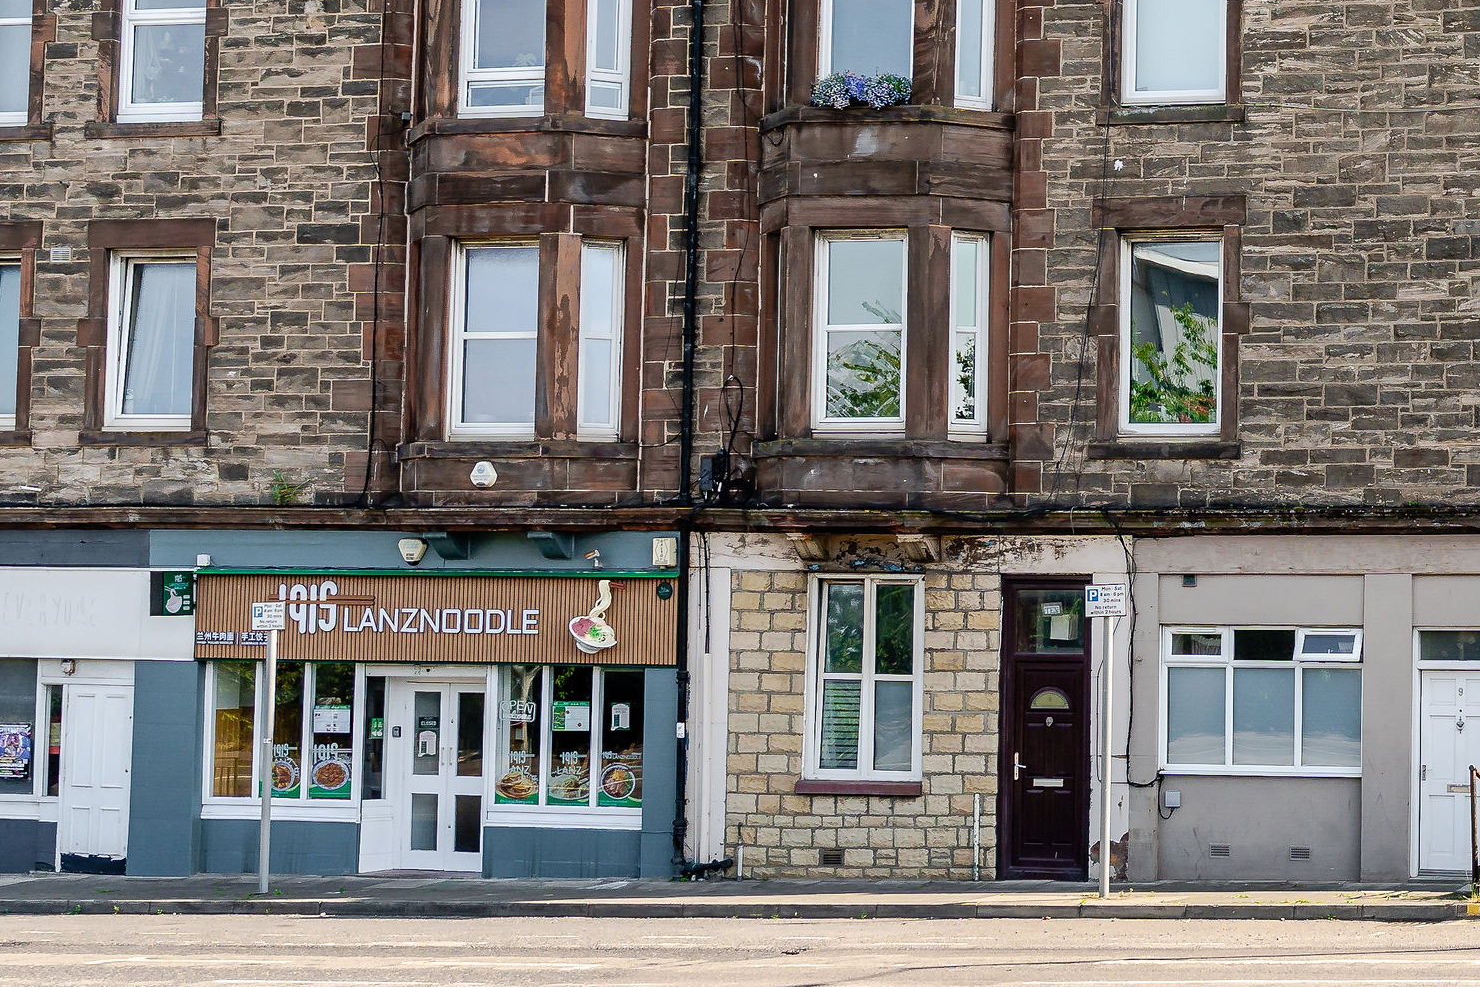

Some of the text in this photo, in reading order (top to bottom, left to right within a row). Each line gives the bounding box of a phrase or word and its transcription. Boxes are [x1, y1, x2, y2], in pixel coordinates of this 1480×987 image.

[343, 607, 540, 635] LANZNOODLE
[1458, 687, 1464, 696] 9
[501, 699, 534, 714] OPEN
